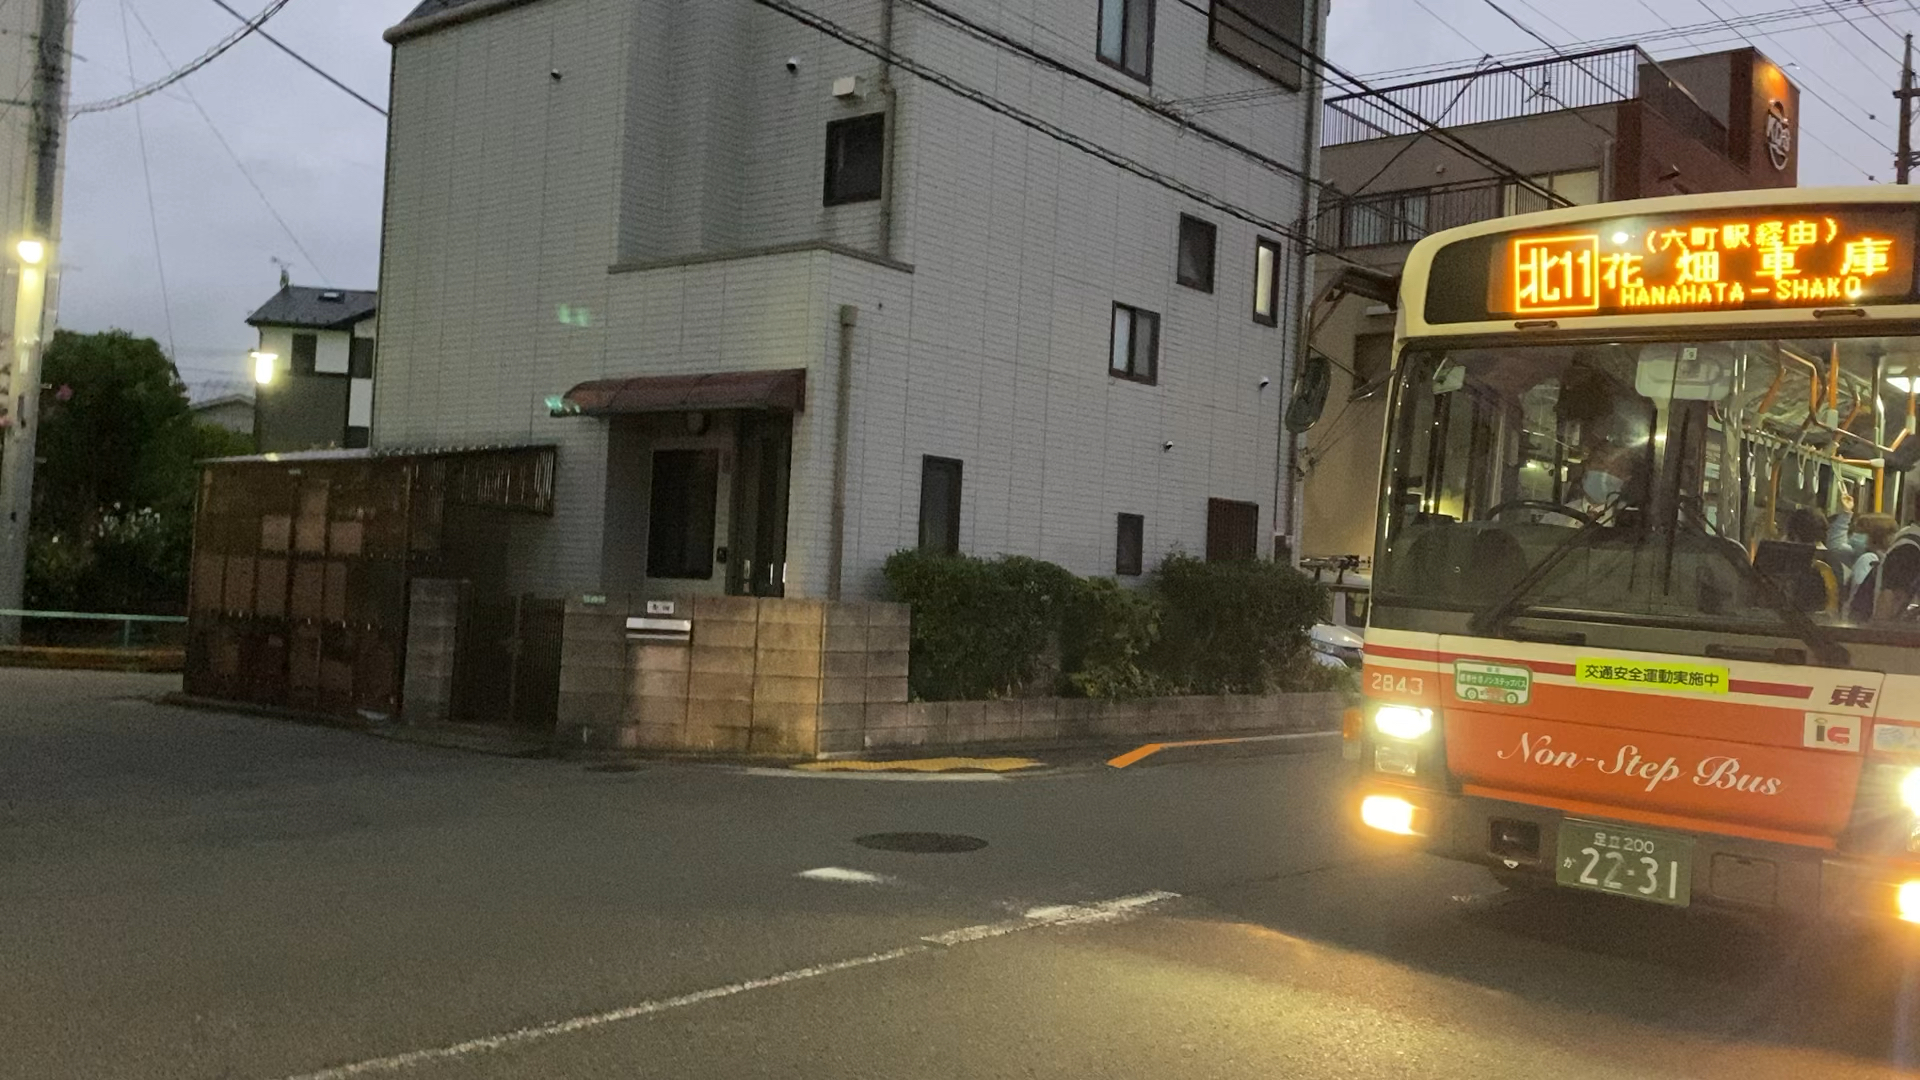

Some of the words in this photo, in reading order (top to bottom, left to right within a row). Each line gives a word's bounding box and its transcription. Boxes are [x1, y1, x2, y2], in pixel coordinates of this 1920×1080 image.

[1372, 672, 1423, 695] 2843
[1585, 664, 1719, 687] 交通安全運動実施中
[1829, 685, 1876, 708] 東
[1497, 732, 1686, 792] Non-Step
[1693, 756, 1785, 795] Bus
[1580, 847, 1677, 898] 22-31
